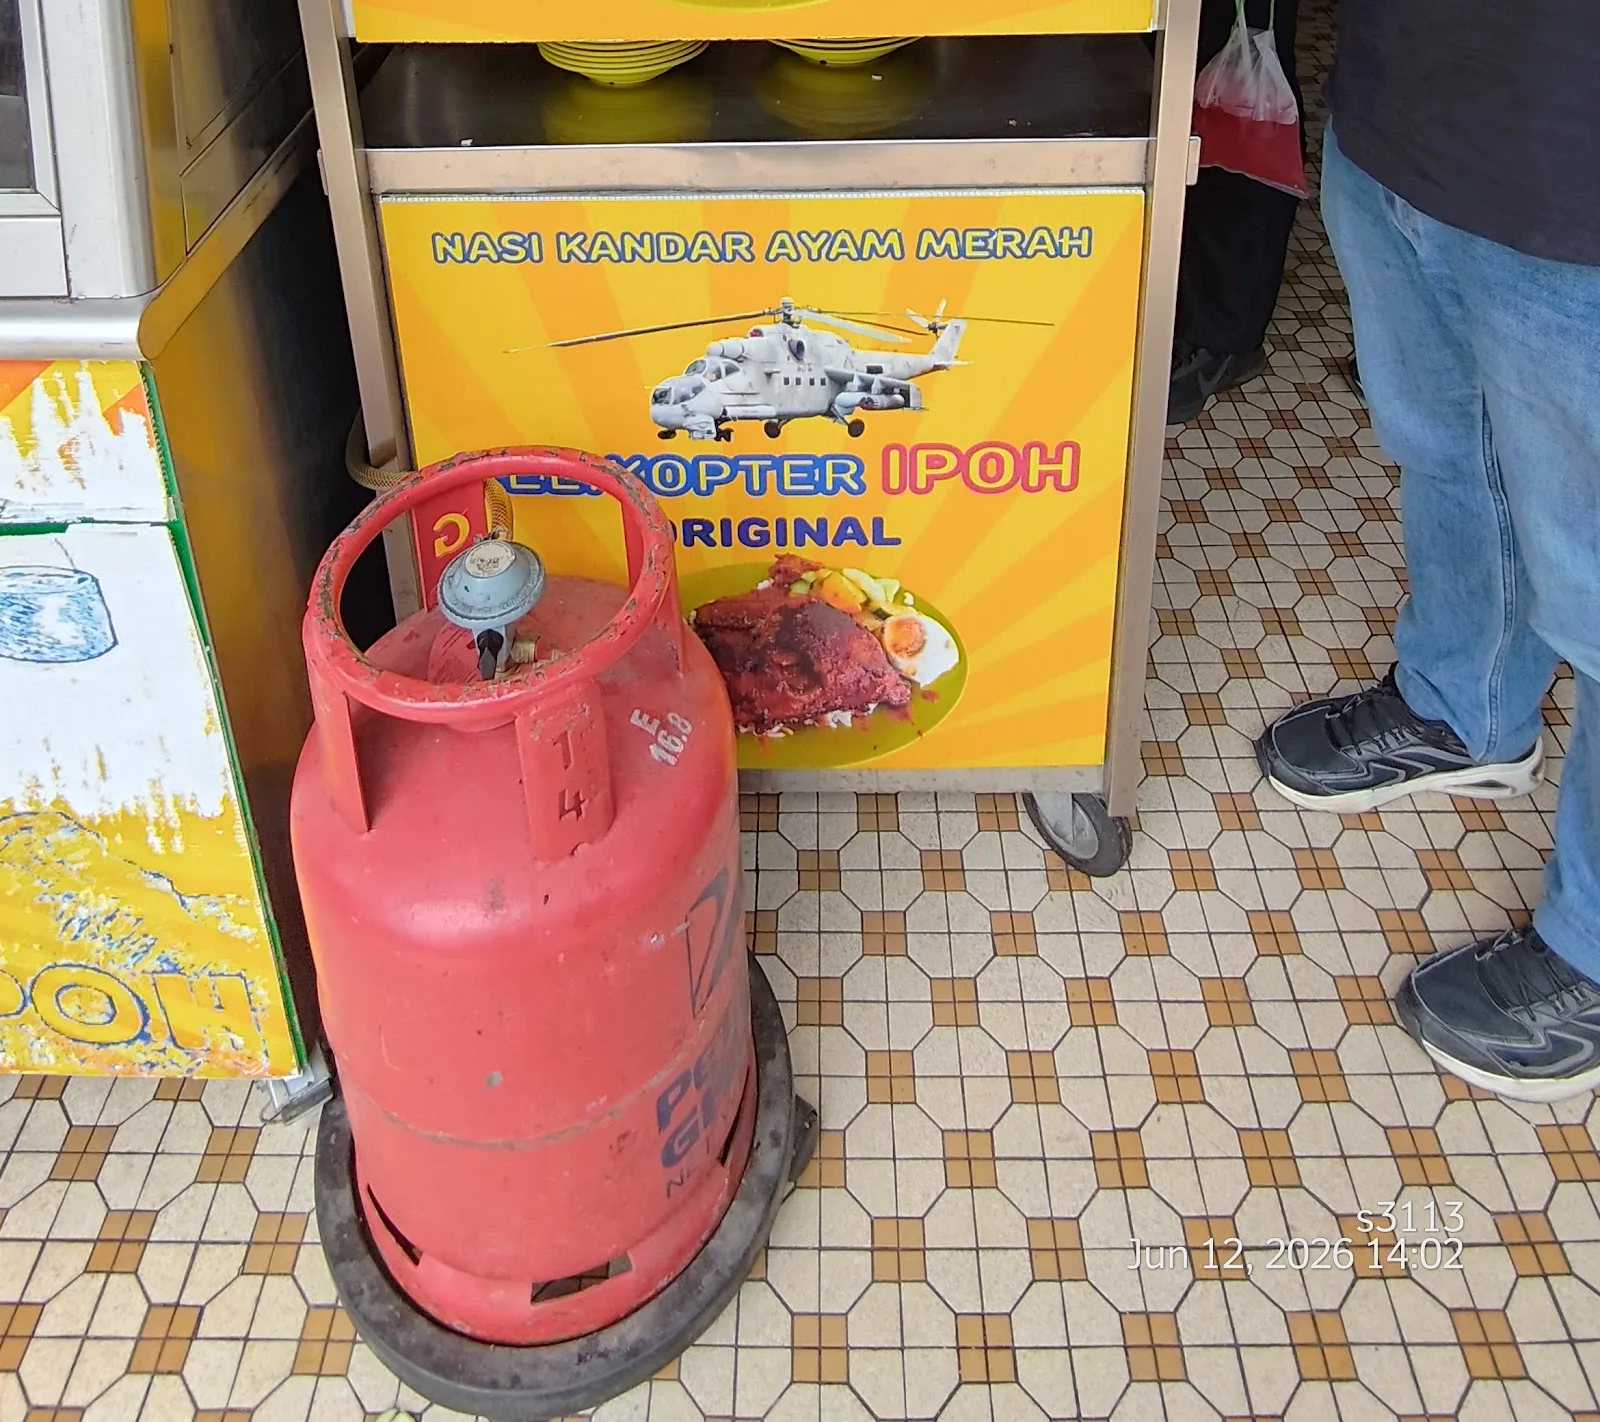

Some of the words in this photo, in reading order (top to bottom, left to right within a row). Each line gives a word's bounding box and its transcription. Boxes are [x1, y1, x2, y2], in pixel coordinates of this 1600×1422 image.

[431, 230, 543, 265] NASI
[555, 229, 755, 264] KANDAR
[765, 228, 904, 263] AYAM
[915, 226, 1093, 261] MERAH
[881, 440, 1082, 494] IPOH
[673, 516, 902, 547] RIGINAL
[629, 708, 660, 737] E
[649, 711, 693, 766] 16.8
